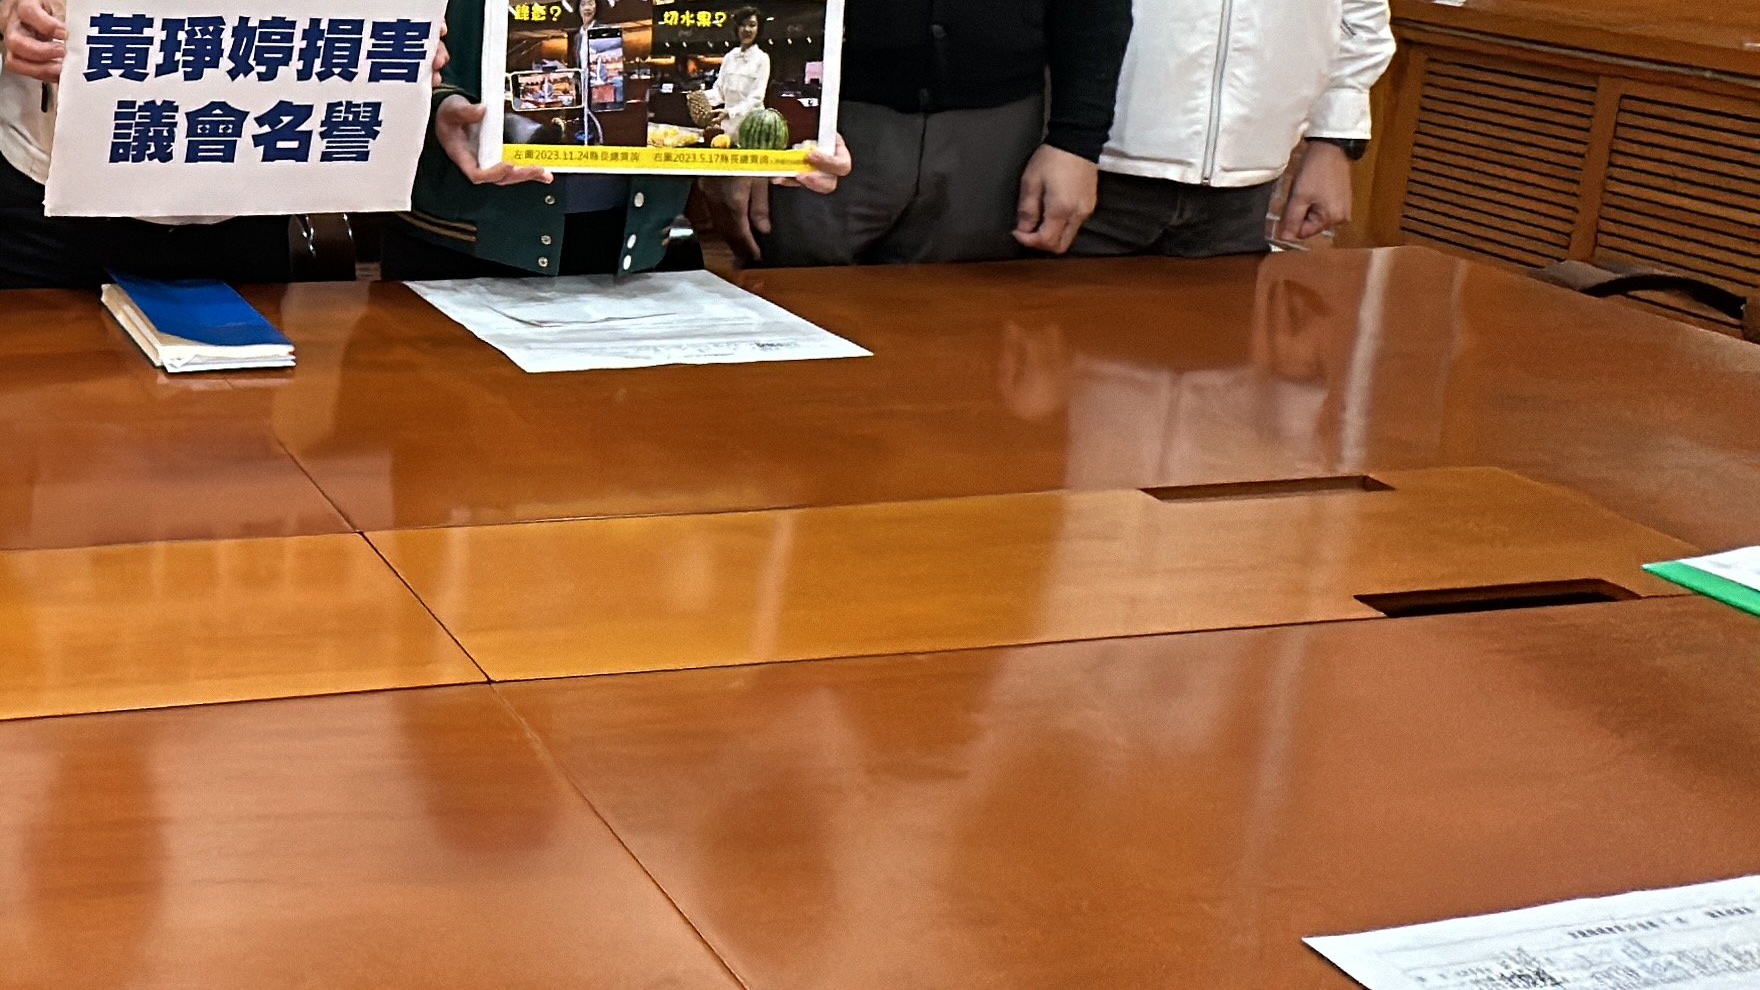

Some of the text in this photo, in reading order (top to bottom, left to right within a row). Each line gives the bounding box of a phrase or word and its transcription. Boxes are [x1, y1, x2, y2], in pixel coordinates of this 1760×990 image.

[82, 12, 432, 84] 黃琤婷損害
[108, 99, 383, 165] 議會名譽
